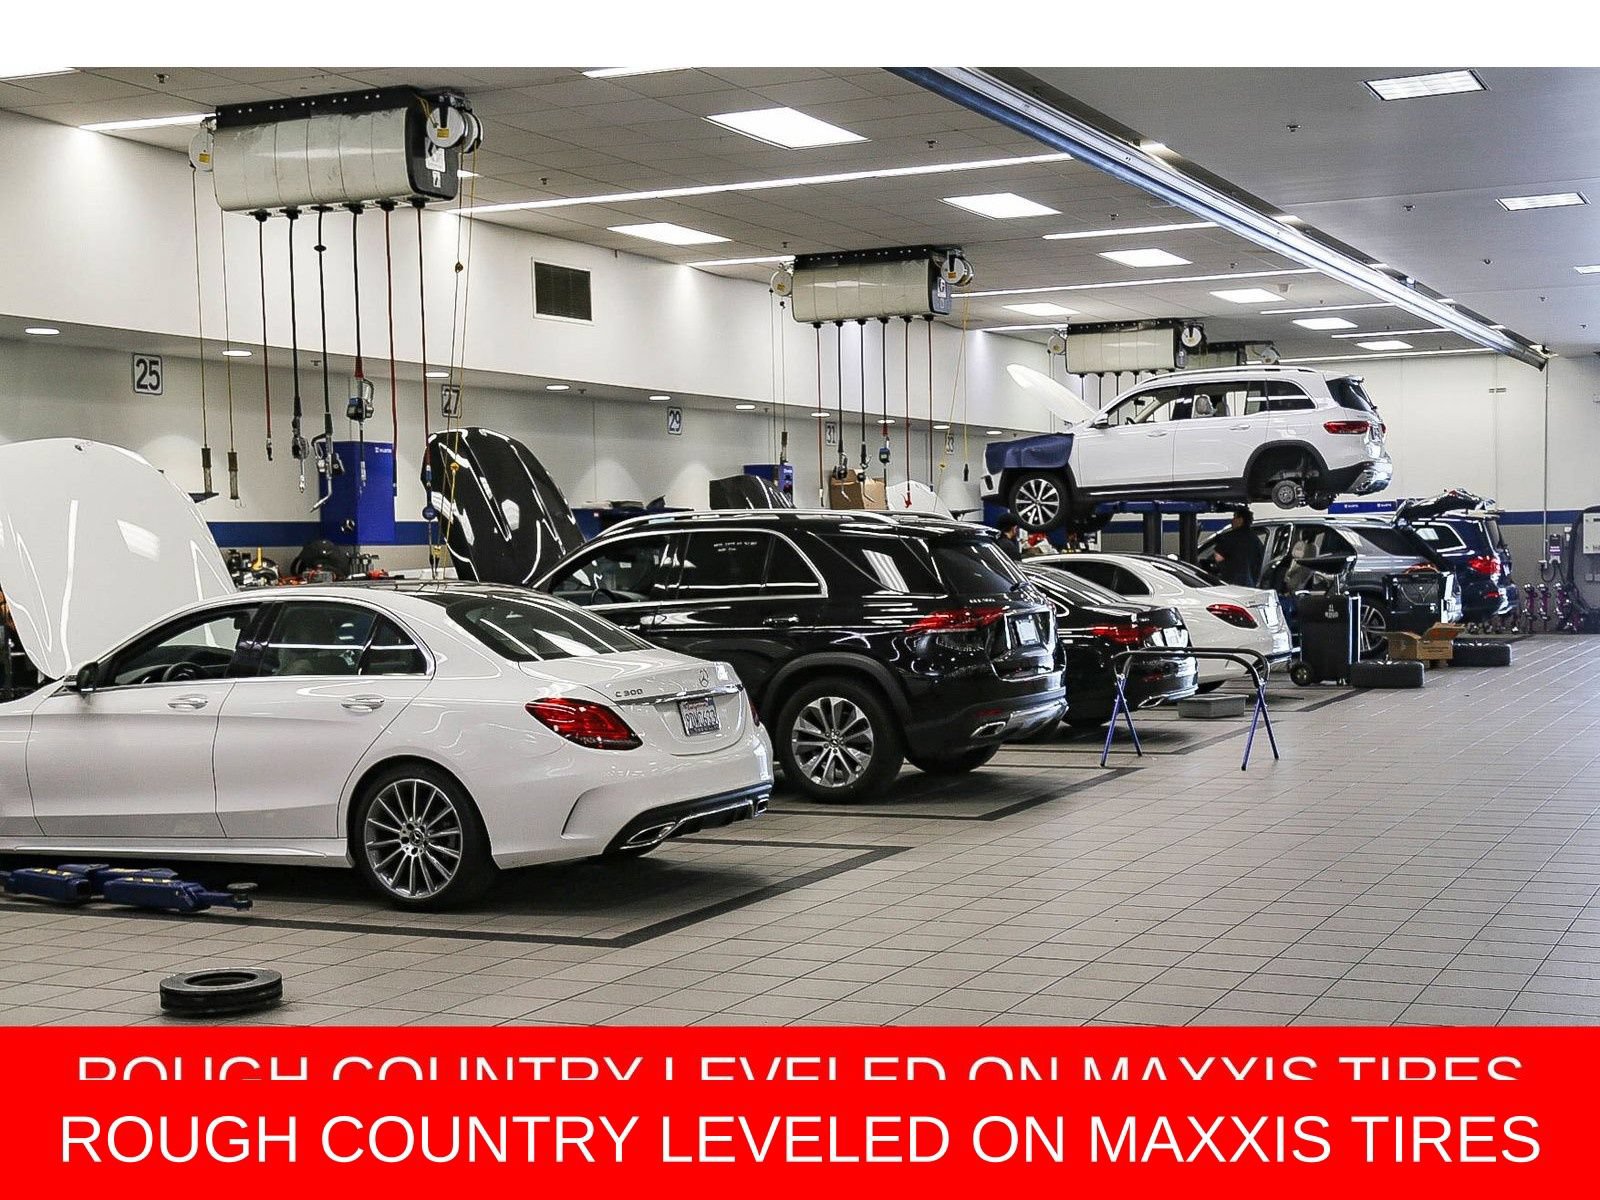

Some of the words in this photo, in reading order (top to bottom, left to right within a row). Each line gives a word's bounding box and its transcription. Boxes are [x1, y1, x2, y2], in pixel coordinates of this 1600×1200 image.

[136, 358, 160, 390] 25
[443, 388, 460, 414] 27
[670, 410, 681, 432] 29
[623, 688, 643, 697] 300
